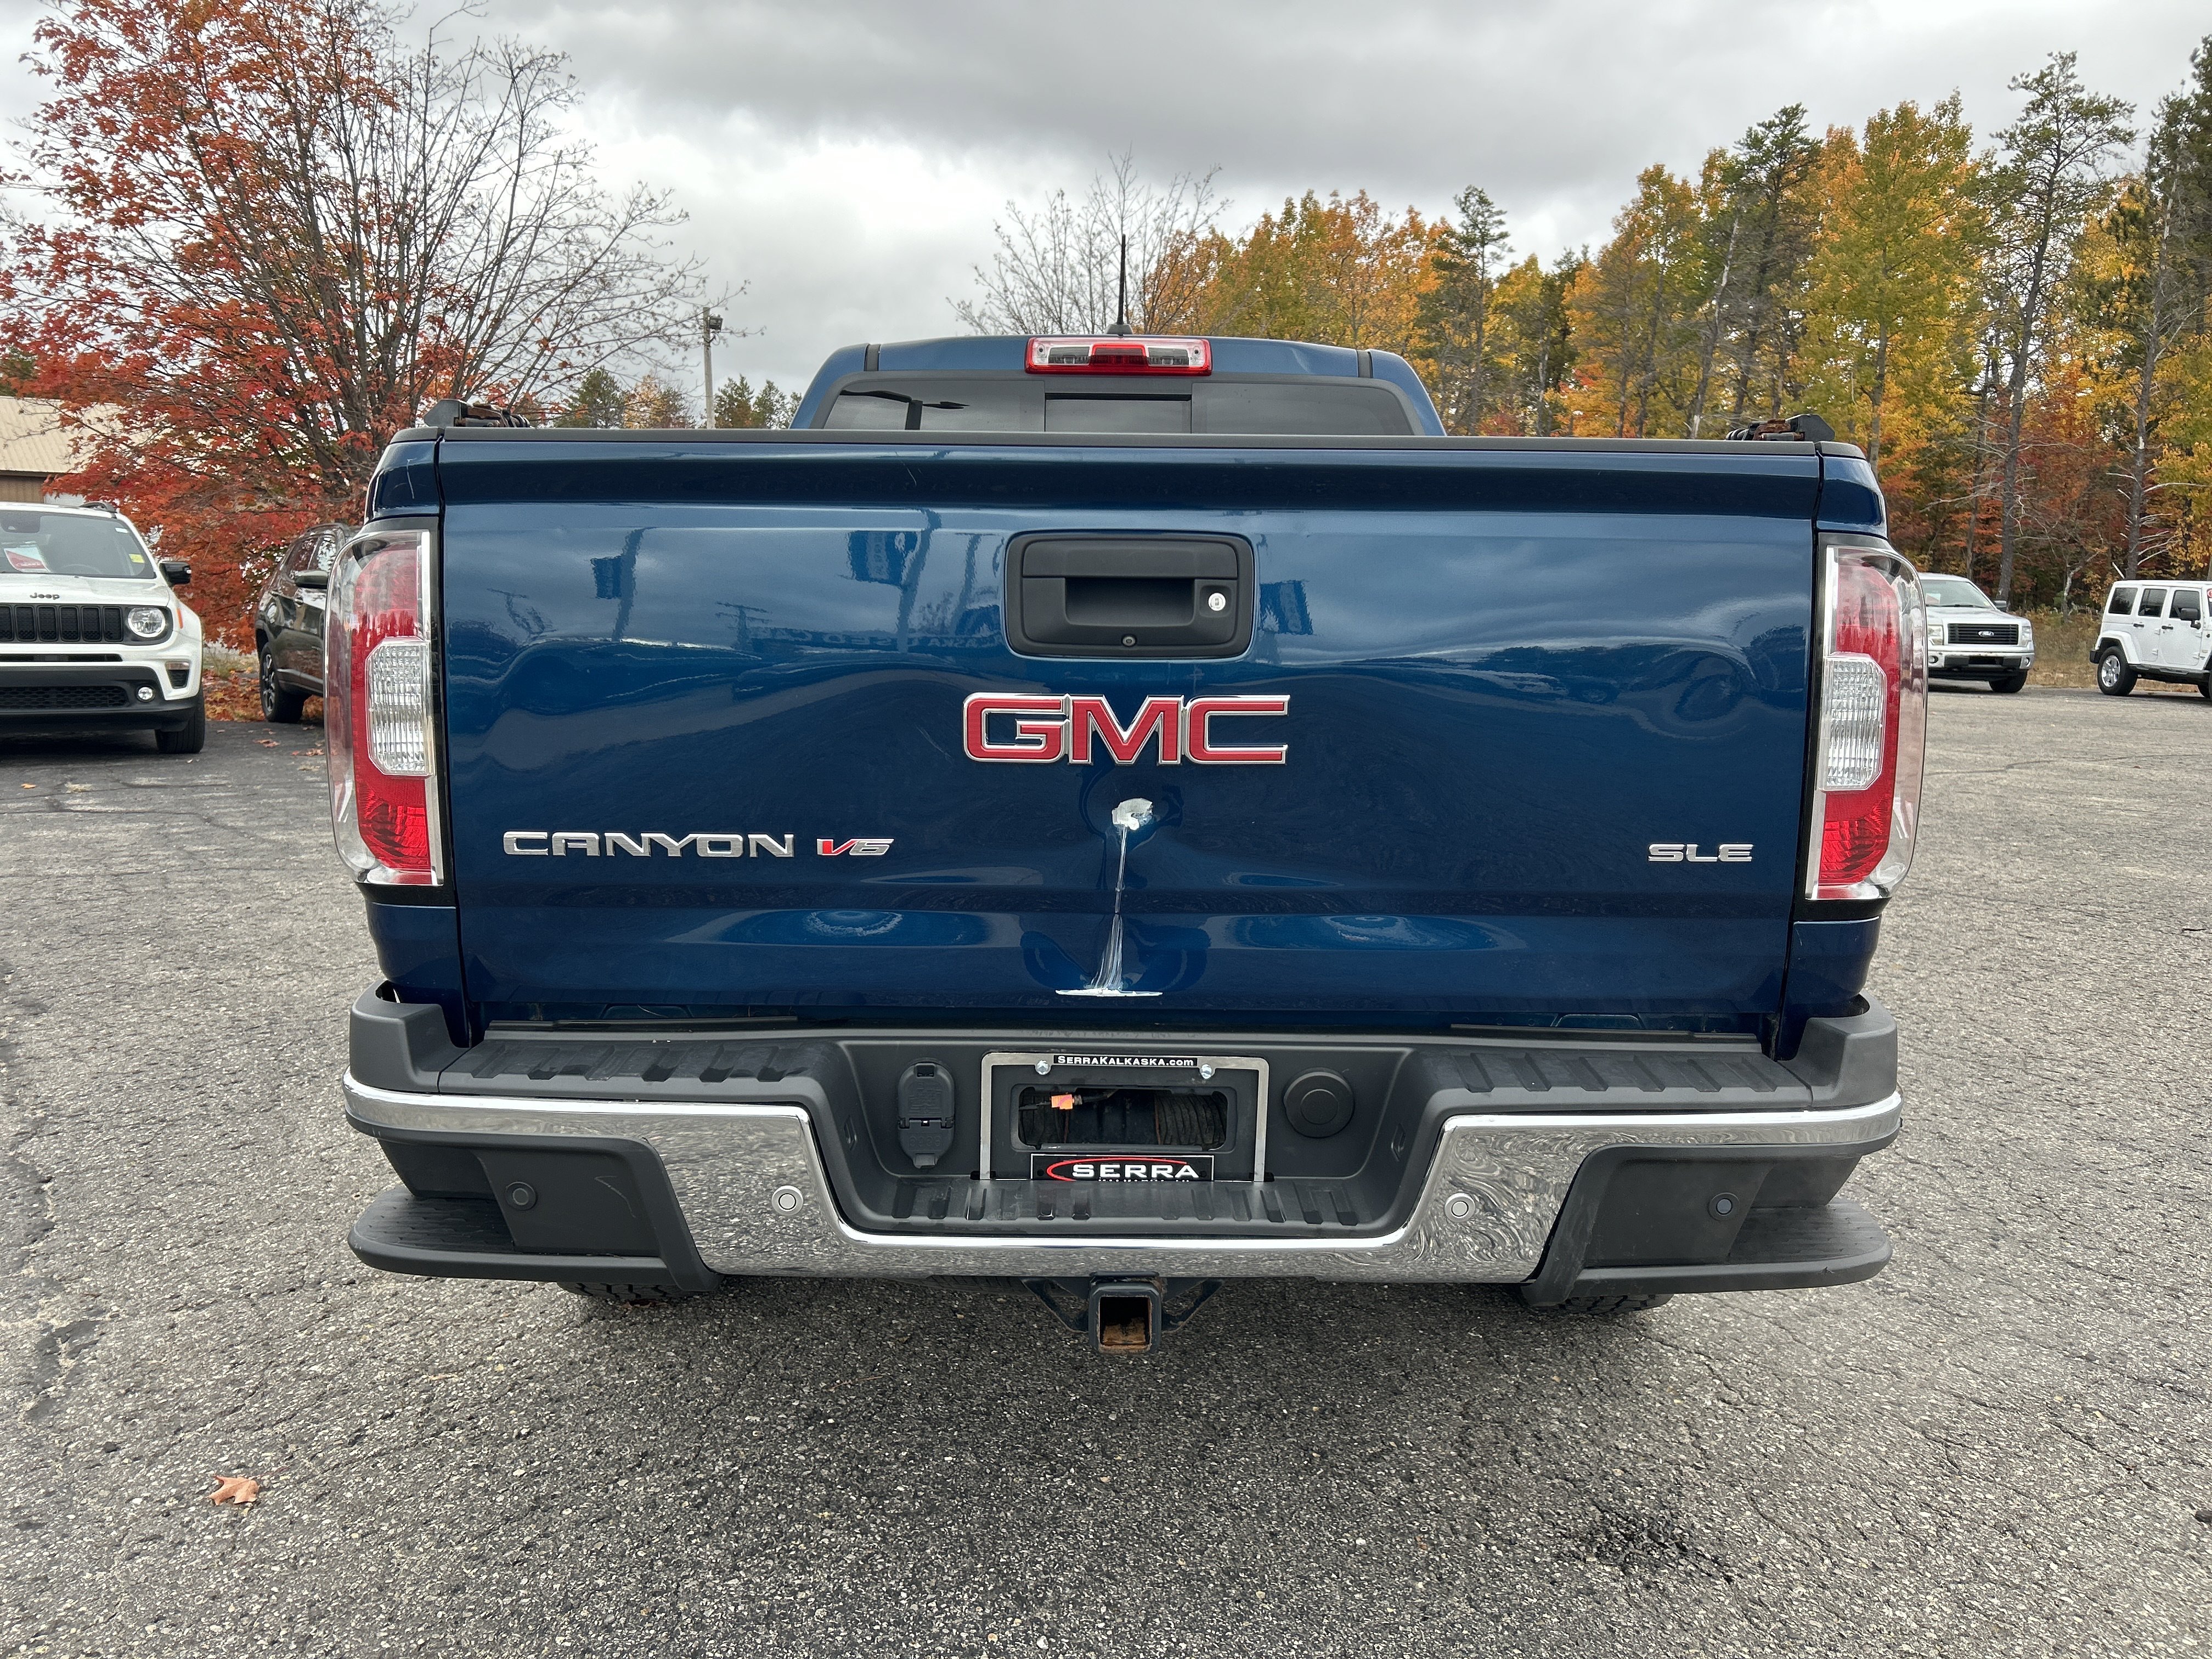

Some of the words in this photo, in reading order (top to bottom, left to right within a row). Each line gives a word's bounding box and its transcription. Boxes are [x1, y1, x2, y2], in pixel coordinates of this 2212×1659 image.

[963, 691, 1291, 765] GMC
[503, 831, 794, 857] CANYON
[816, 838, 895, 856] V6
[1648, 843, 1754, 862] SLE
[1071, 1164, 1199, 1178] SERRA
